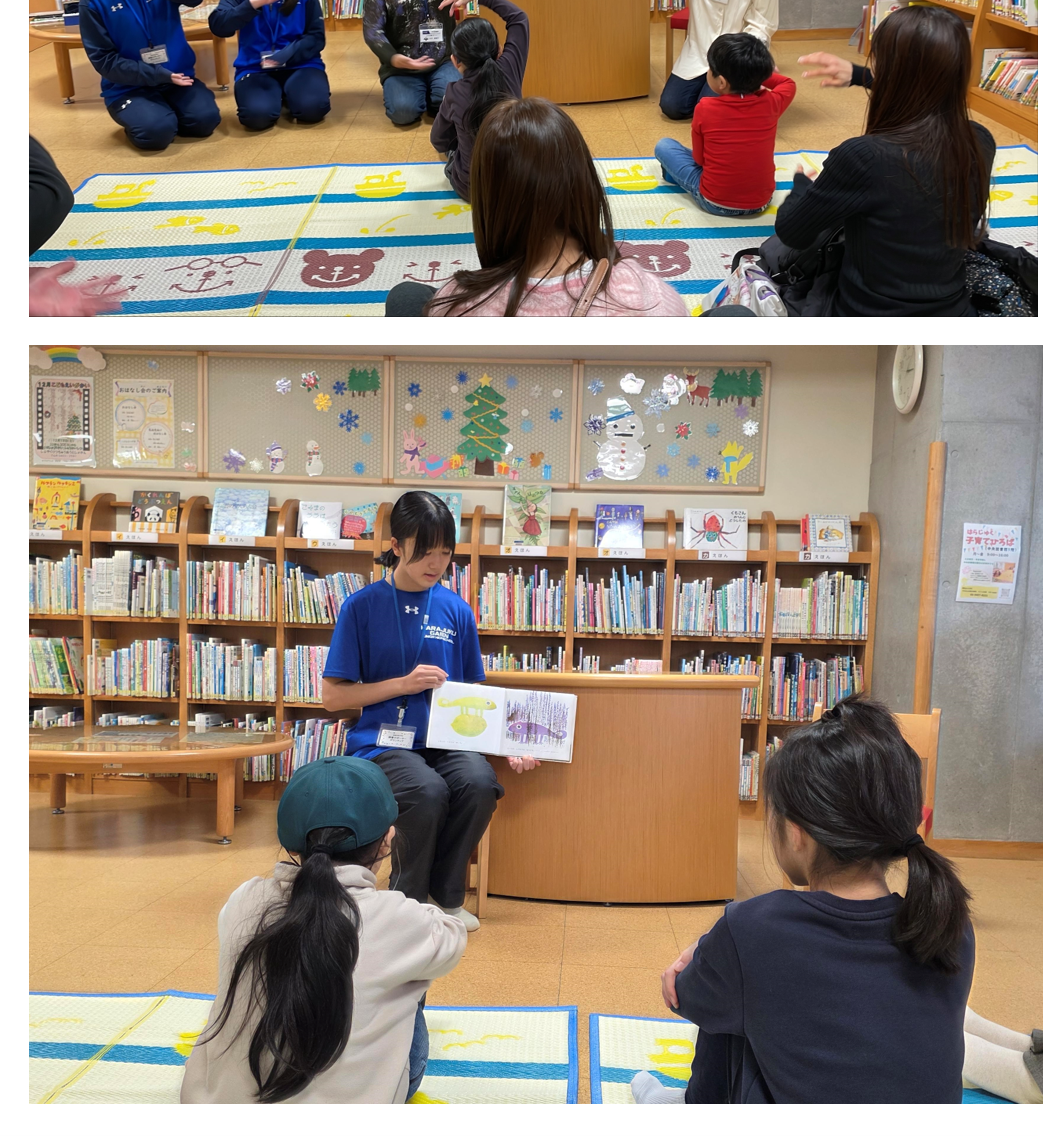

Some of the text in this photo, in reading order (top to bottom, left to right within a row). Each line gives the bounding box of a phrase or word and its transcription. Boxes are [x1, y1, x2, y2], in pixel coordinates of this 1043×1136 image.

[965, 536, 1015, 546] 子育てひろば
